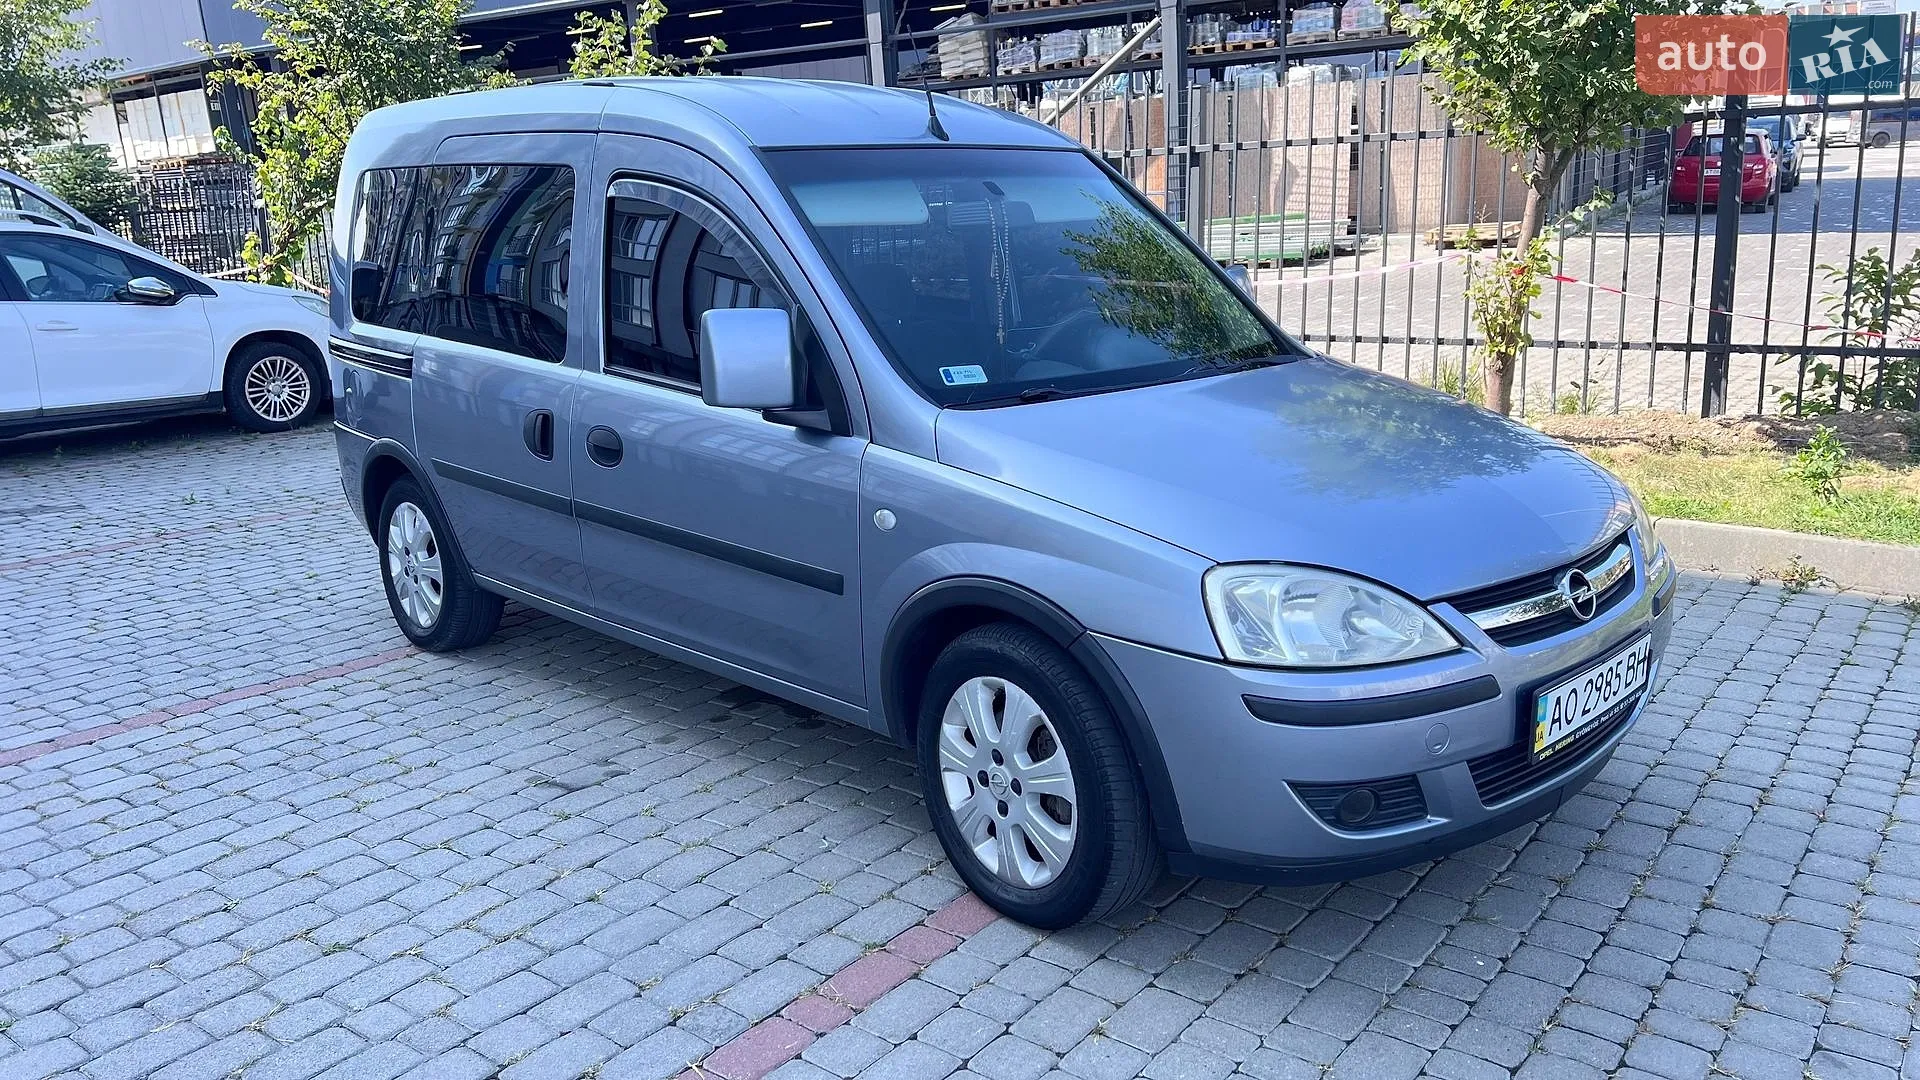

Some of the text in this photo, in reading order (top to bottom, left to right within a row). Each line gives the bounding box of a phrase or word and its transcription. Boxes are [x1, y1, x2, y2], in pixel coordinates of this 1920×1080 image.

[1548, 642, 1648, 737] AO 2985 BH
[1535, 731, 1544, 744] UA
